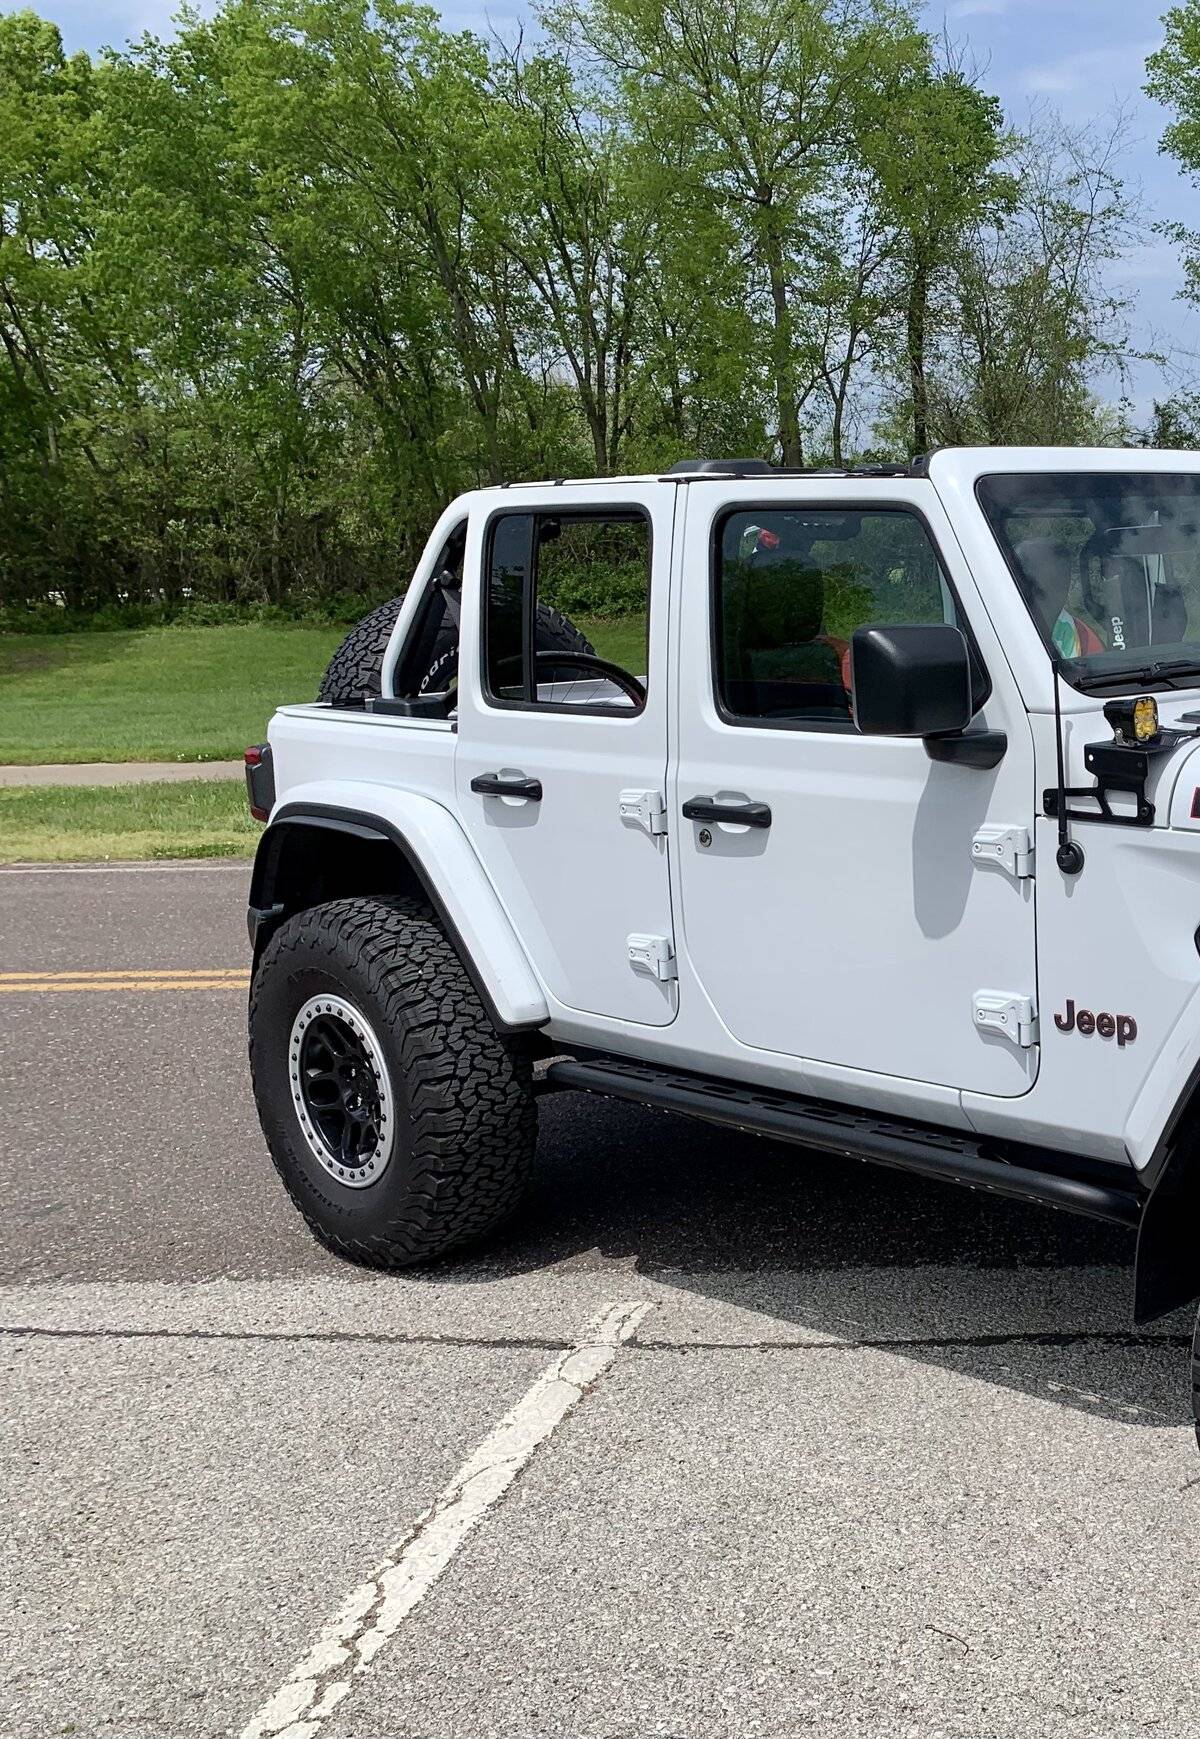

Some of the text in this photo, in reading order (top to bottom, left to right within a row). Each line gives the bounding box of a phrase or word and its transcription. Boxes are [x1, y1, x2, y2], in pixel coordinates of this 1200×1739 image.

[1111, 616, 1126, 651] Jeep
[419, 646, 459, 694] odri
[1053, 999, 1138, 1046] Jeep
